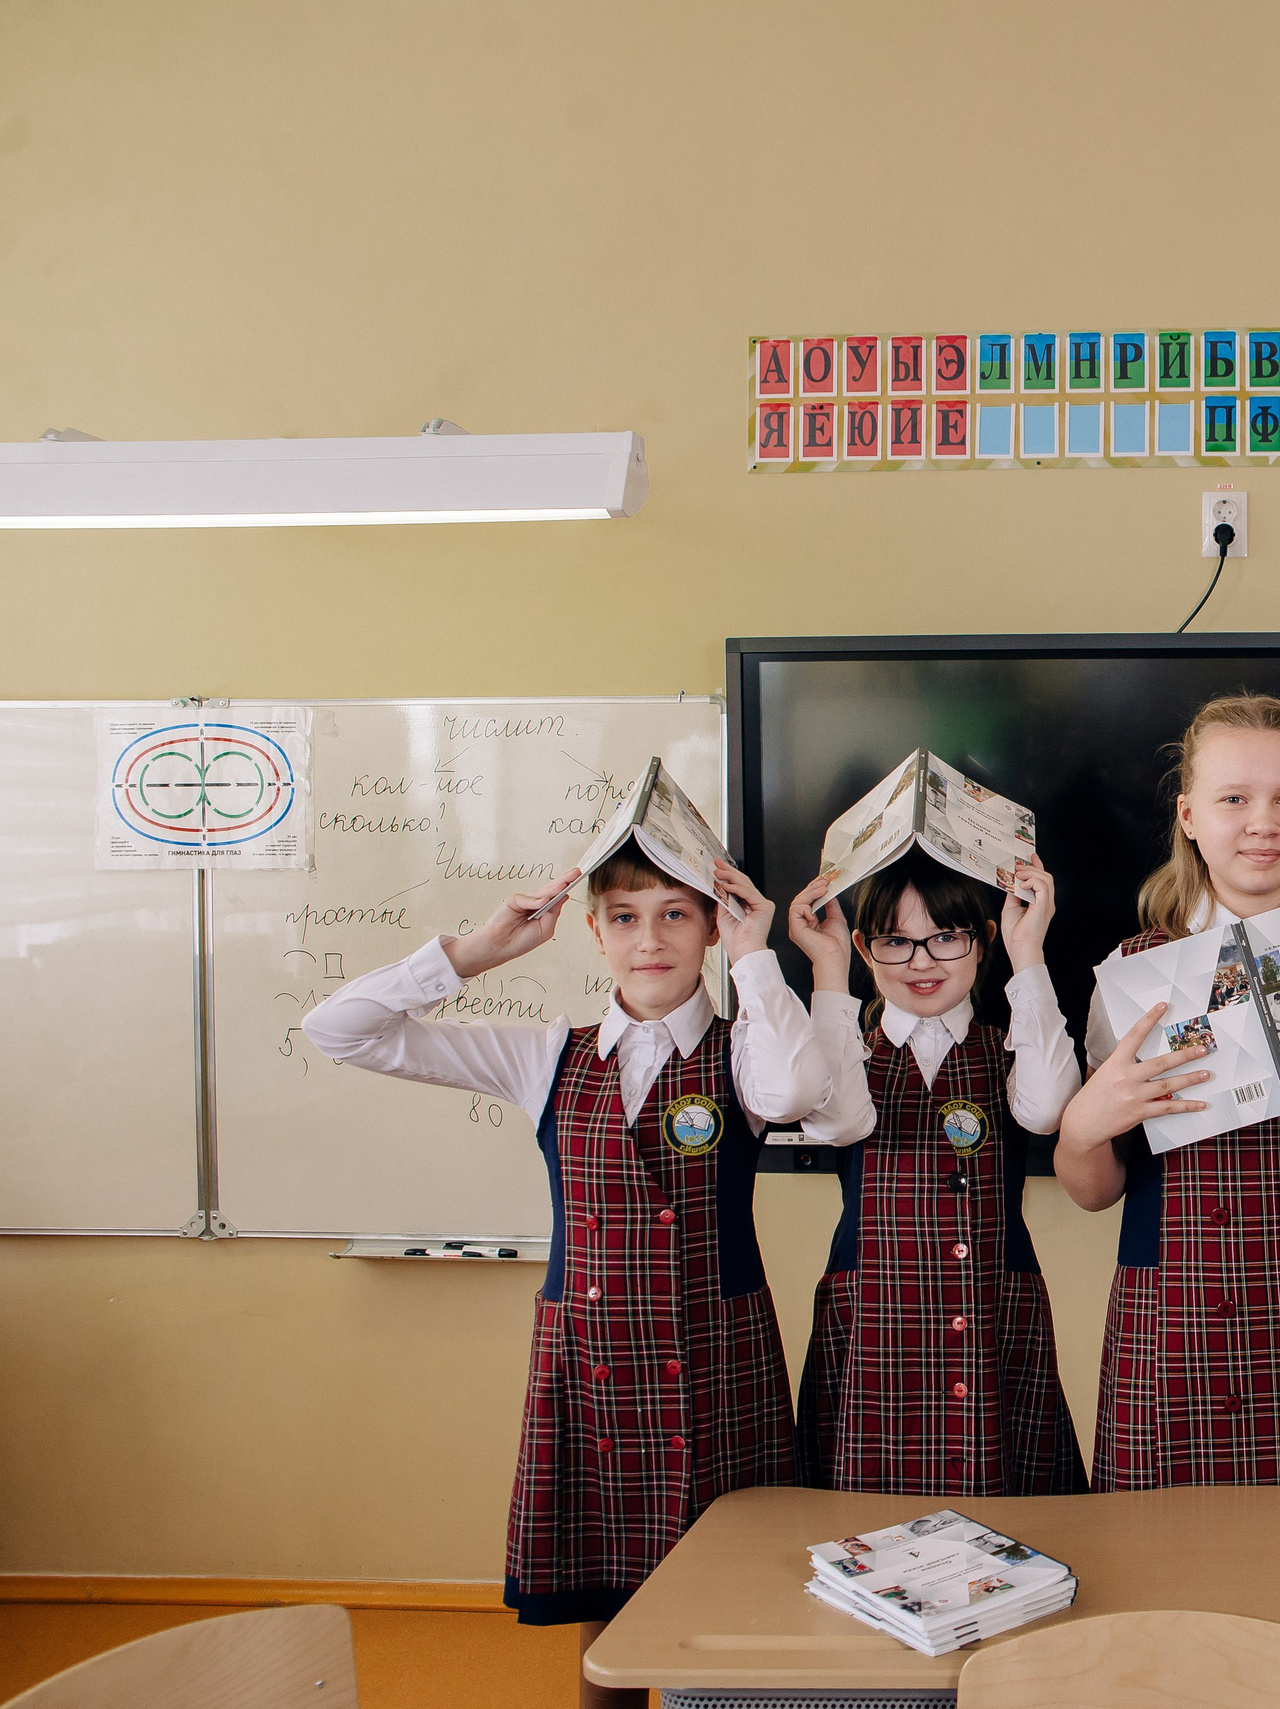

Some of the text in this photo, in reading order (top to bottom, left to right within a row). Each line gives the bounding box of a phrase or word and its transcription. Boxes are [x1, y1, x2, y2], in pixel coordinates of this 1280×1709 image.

[760, 344, 790, 383] А
[803, 346, 831, 383] О
[847, 345, 876, 383] У
[891, 344, 921, 382] Ы
[937, 344, 966, 382] Э
[979, 343, 1012, 381] Л
[1024, 343, 1055, 381] М
[1071, 342, 1099, 380] Н
[1115, 342, 1143, 381] Р
[1206, 341, 1234, 378] Б
[1251, 341, 1280, 379] В
[759, 410, 786, 449] Я
[847, 410, 877, 447] Ю
[890, 408, 922, 447] И
[937, 407, 967, 446] Е
[1205, 405, 1236, 443] П
[1251, 406, 1279, 443] Ф
[211, 849, 225, 857] ДЛЯ
[284, 903, 411, 944] простые
[668, 1097, 716, 1117] МАОУ СОШ
[941, 1102, 984, 1120] МАОУ СОШ
